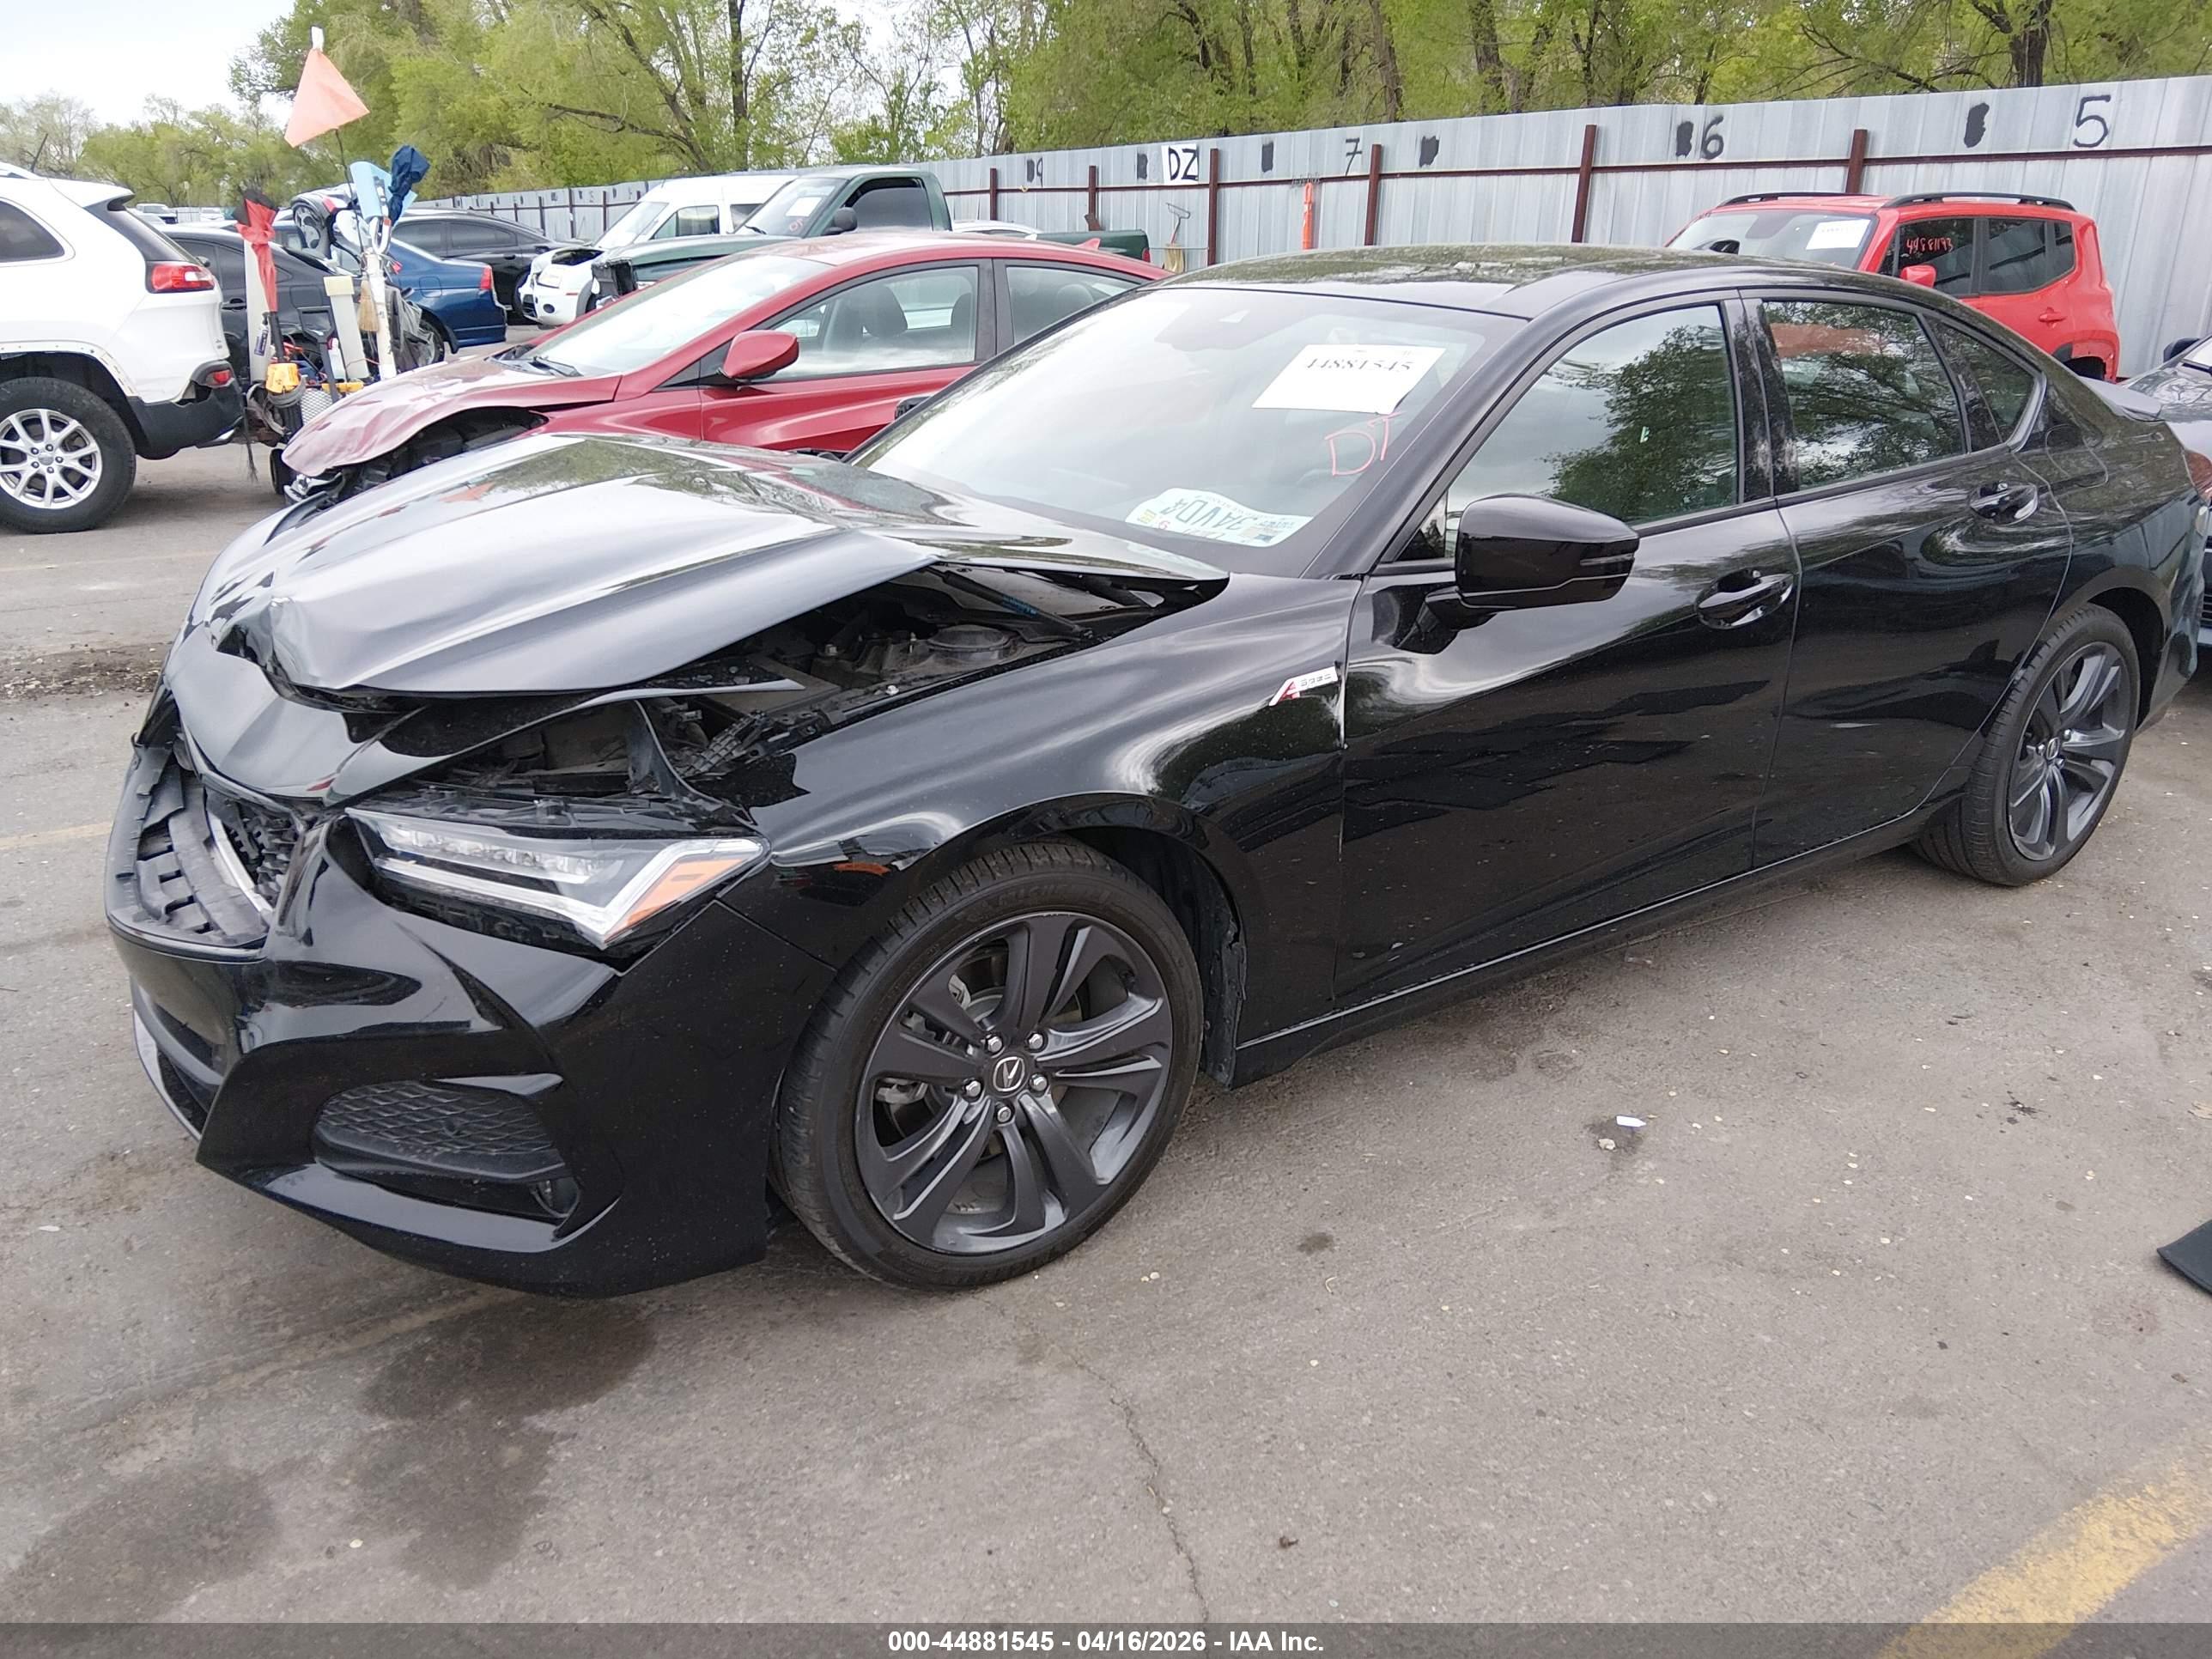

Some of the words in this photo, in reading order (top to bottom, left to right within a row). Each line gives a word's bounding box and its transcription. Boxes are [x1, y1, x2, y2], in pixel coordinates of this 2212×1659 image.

[1701, 114, 1724, 160] 6
[2073, 94, 2112, 148] 5
[1345, 137, 1363, 177] 7
